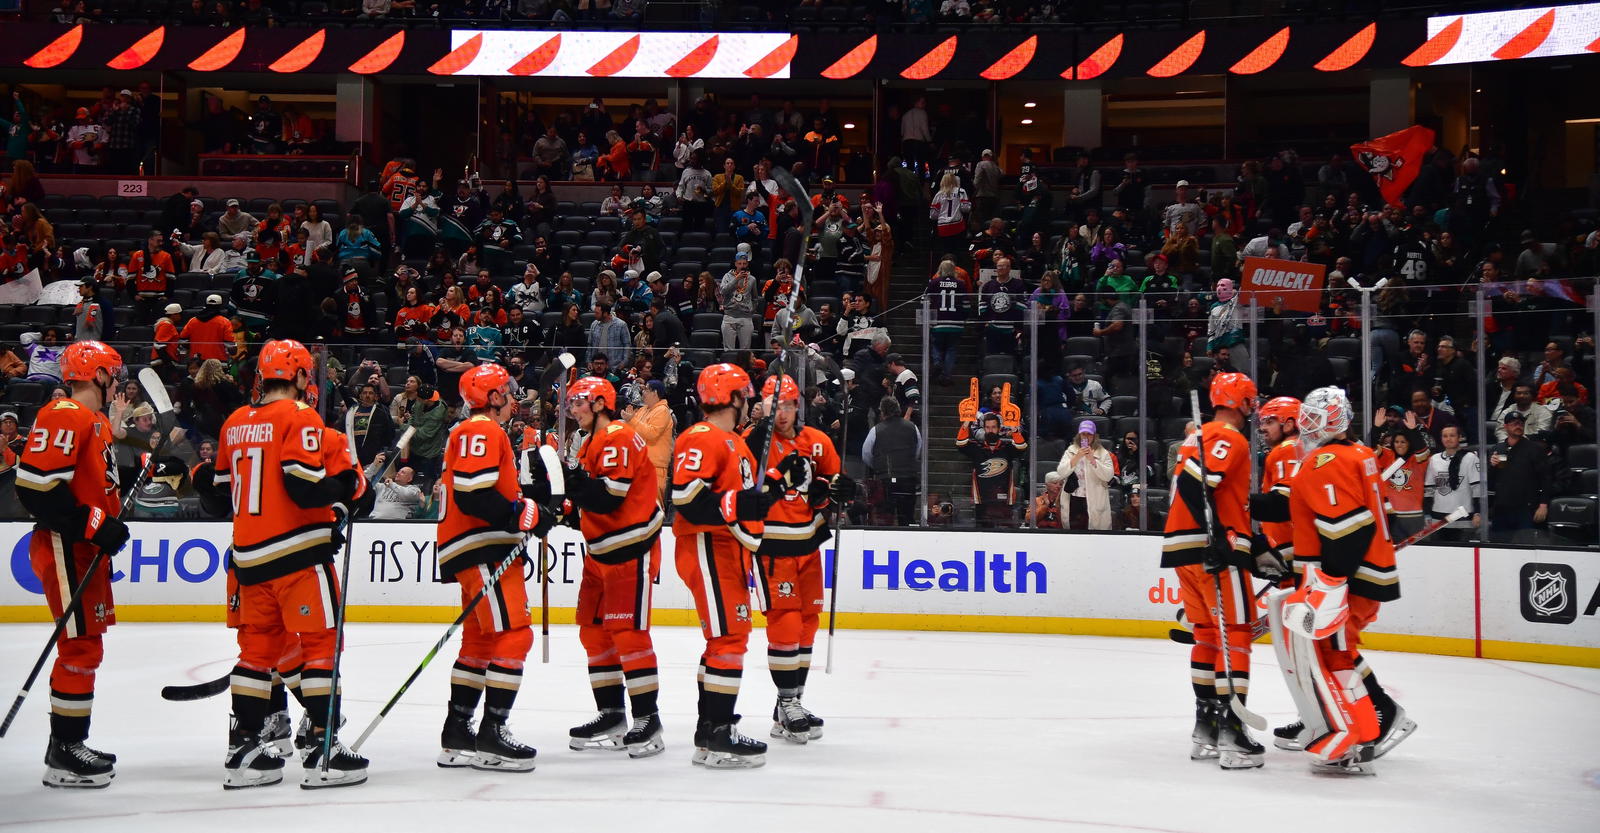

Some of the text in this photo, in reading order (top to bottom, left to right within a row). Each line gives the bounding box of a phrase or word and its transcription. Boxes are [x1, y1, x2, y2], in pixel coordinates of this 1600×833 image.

[122, 184, 143, 194] 223
[1251, 267, 1315, 290] QUACK!
[1400, 259, 1427, 281] 48
[939, 289, 957, 312] 11
[30, 427, 75, 456] 34
[226, 422, 274, 446] GAUTHIER
[301, 426, 323, 452] 61
[459, 433, 487, 458] 16
[603, 446, 629, 468] 21
[676, 448, 703, 472] 73
[812, 442, 824, 457] A
[1210, 439, 1232, 460] 6
[231, 446, 263, 517] 61
[1275, 460, 1303, 480] 17
[1323, 483, 1338, 506] 1
[111, 538, 234, 584] HO
[862, 550, 1047, 594] Health
[1537, 583, 1560, 605] NHL
